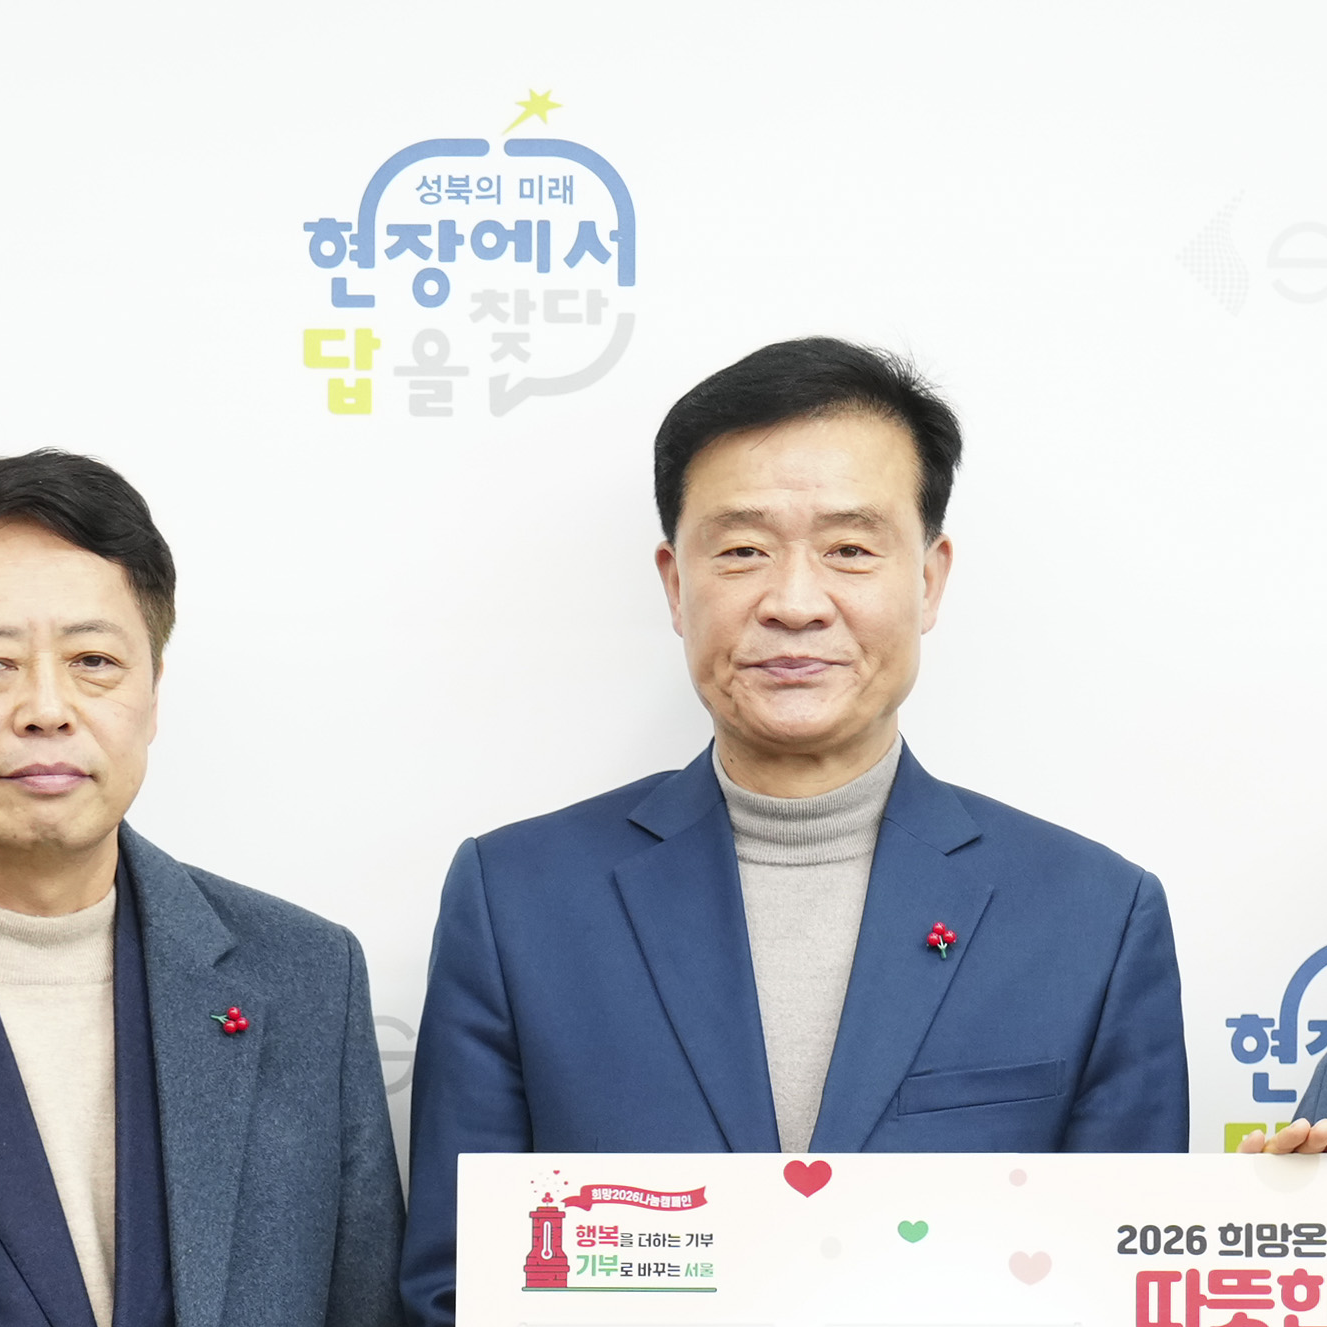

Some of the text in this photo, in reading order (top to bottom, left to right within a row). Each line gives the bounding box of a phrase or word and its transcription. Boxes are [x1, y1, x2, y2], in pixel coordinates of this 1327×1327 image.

[415, 175, 574, 206] 성북의 미래
[303, 217, 636, 309] 현장에서
[576, 1225, 715, 1248] 행복을 더하는 기부
[1117, 1224, 1207, 1256] 2026
[576, 1255, 714, 1278] 기부로 바꾸는 서울
